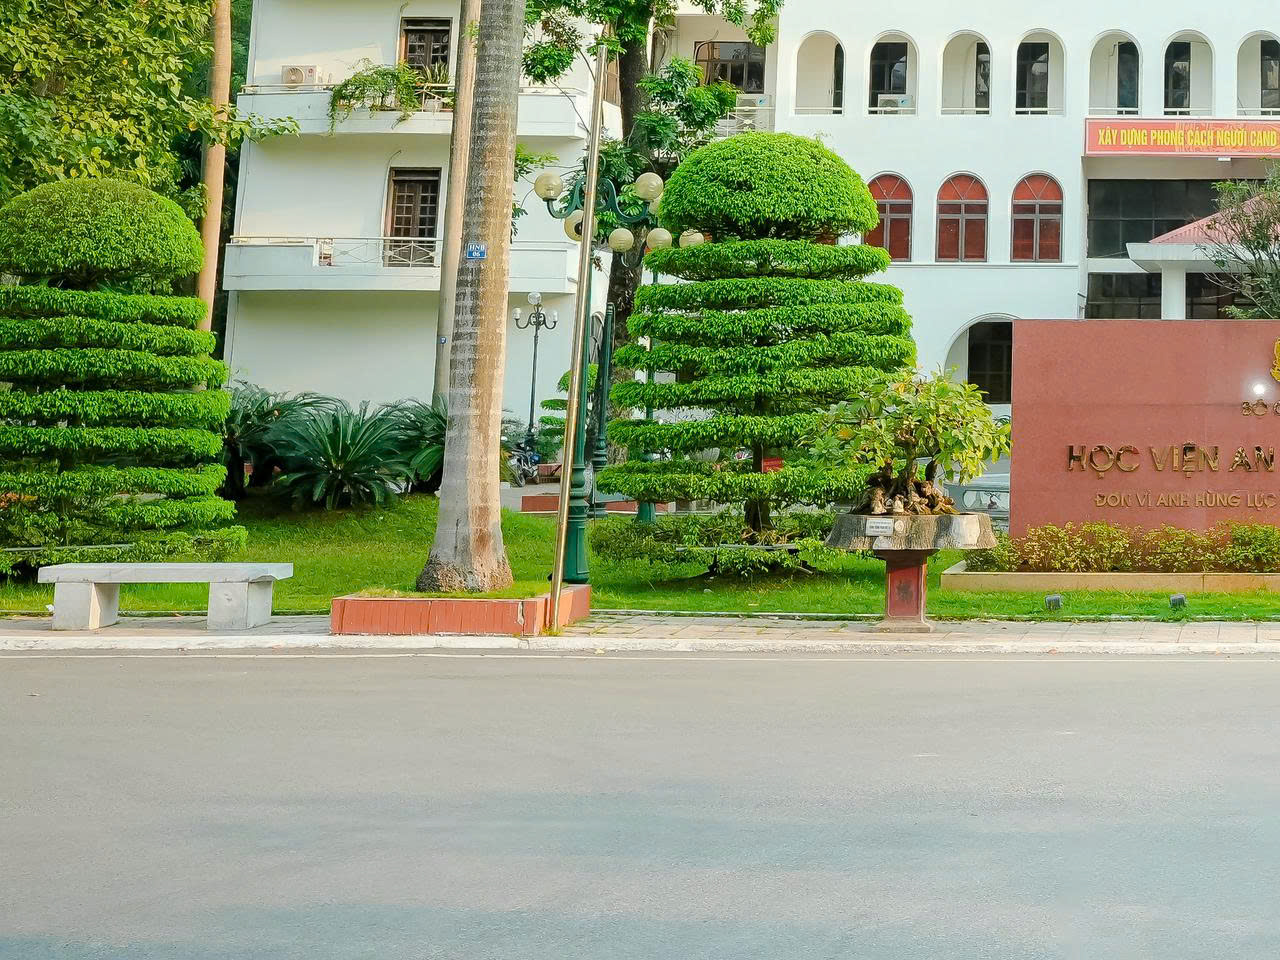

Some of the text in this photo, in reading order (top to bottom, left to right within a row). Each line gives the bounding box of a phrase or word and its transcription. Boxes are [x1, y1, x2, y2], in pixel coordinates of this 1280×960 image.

[1098, 126, 1118, 145] XÂY
[1120, 127, 1148, 149] DỰNG
[1150, 130, 1184, 146] PHONG
[1187, 127, 1213, 146] CÁCH
[1250, 130, 1277, 146] CAND
[1067, 445, 1141, 480] HỌC
[1149, 441, 1219, 479] VIỆN
[1228, 446, 1275, 472] AN
[1156, 493, 1190, 507] ANH
[1195, 489, 1241, 507] HÙNG
